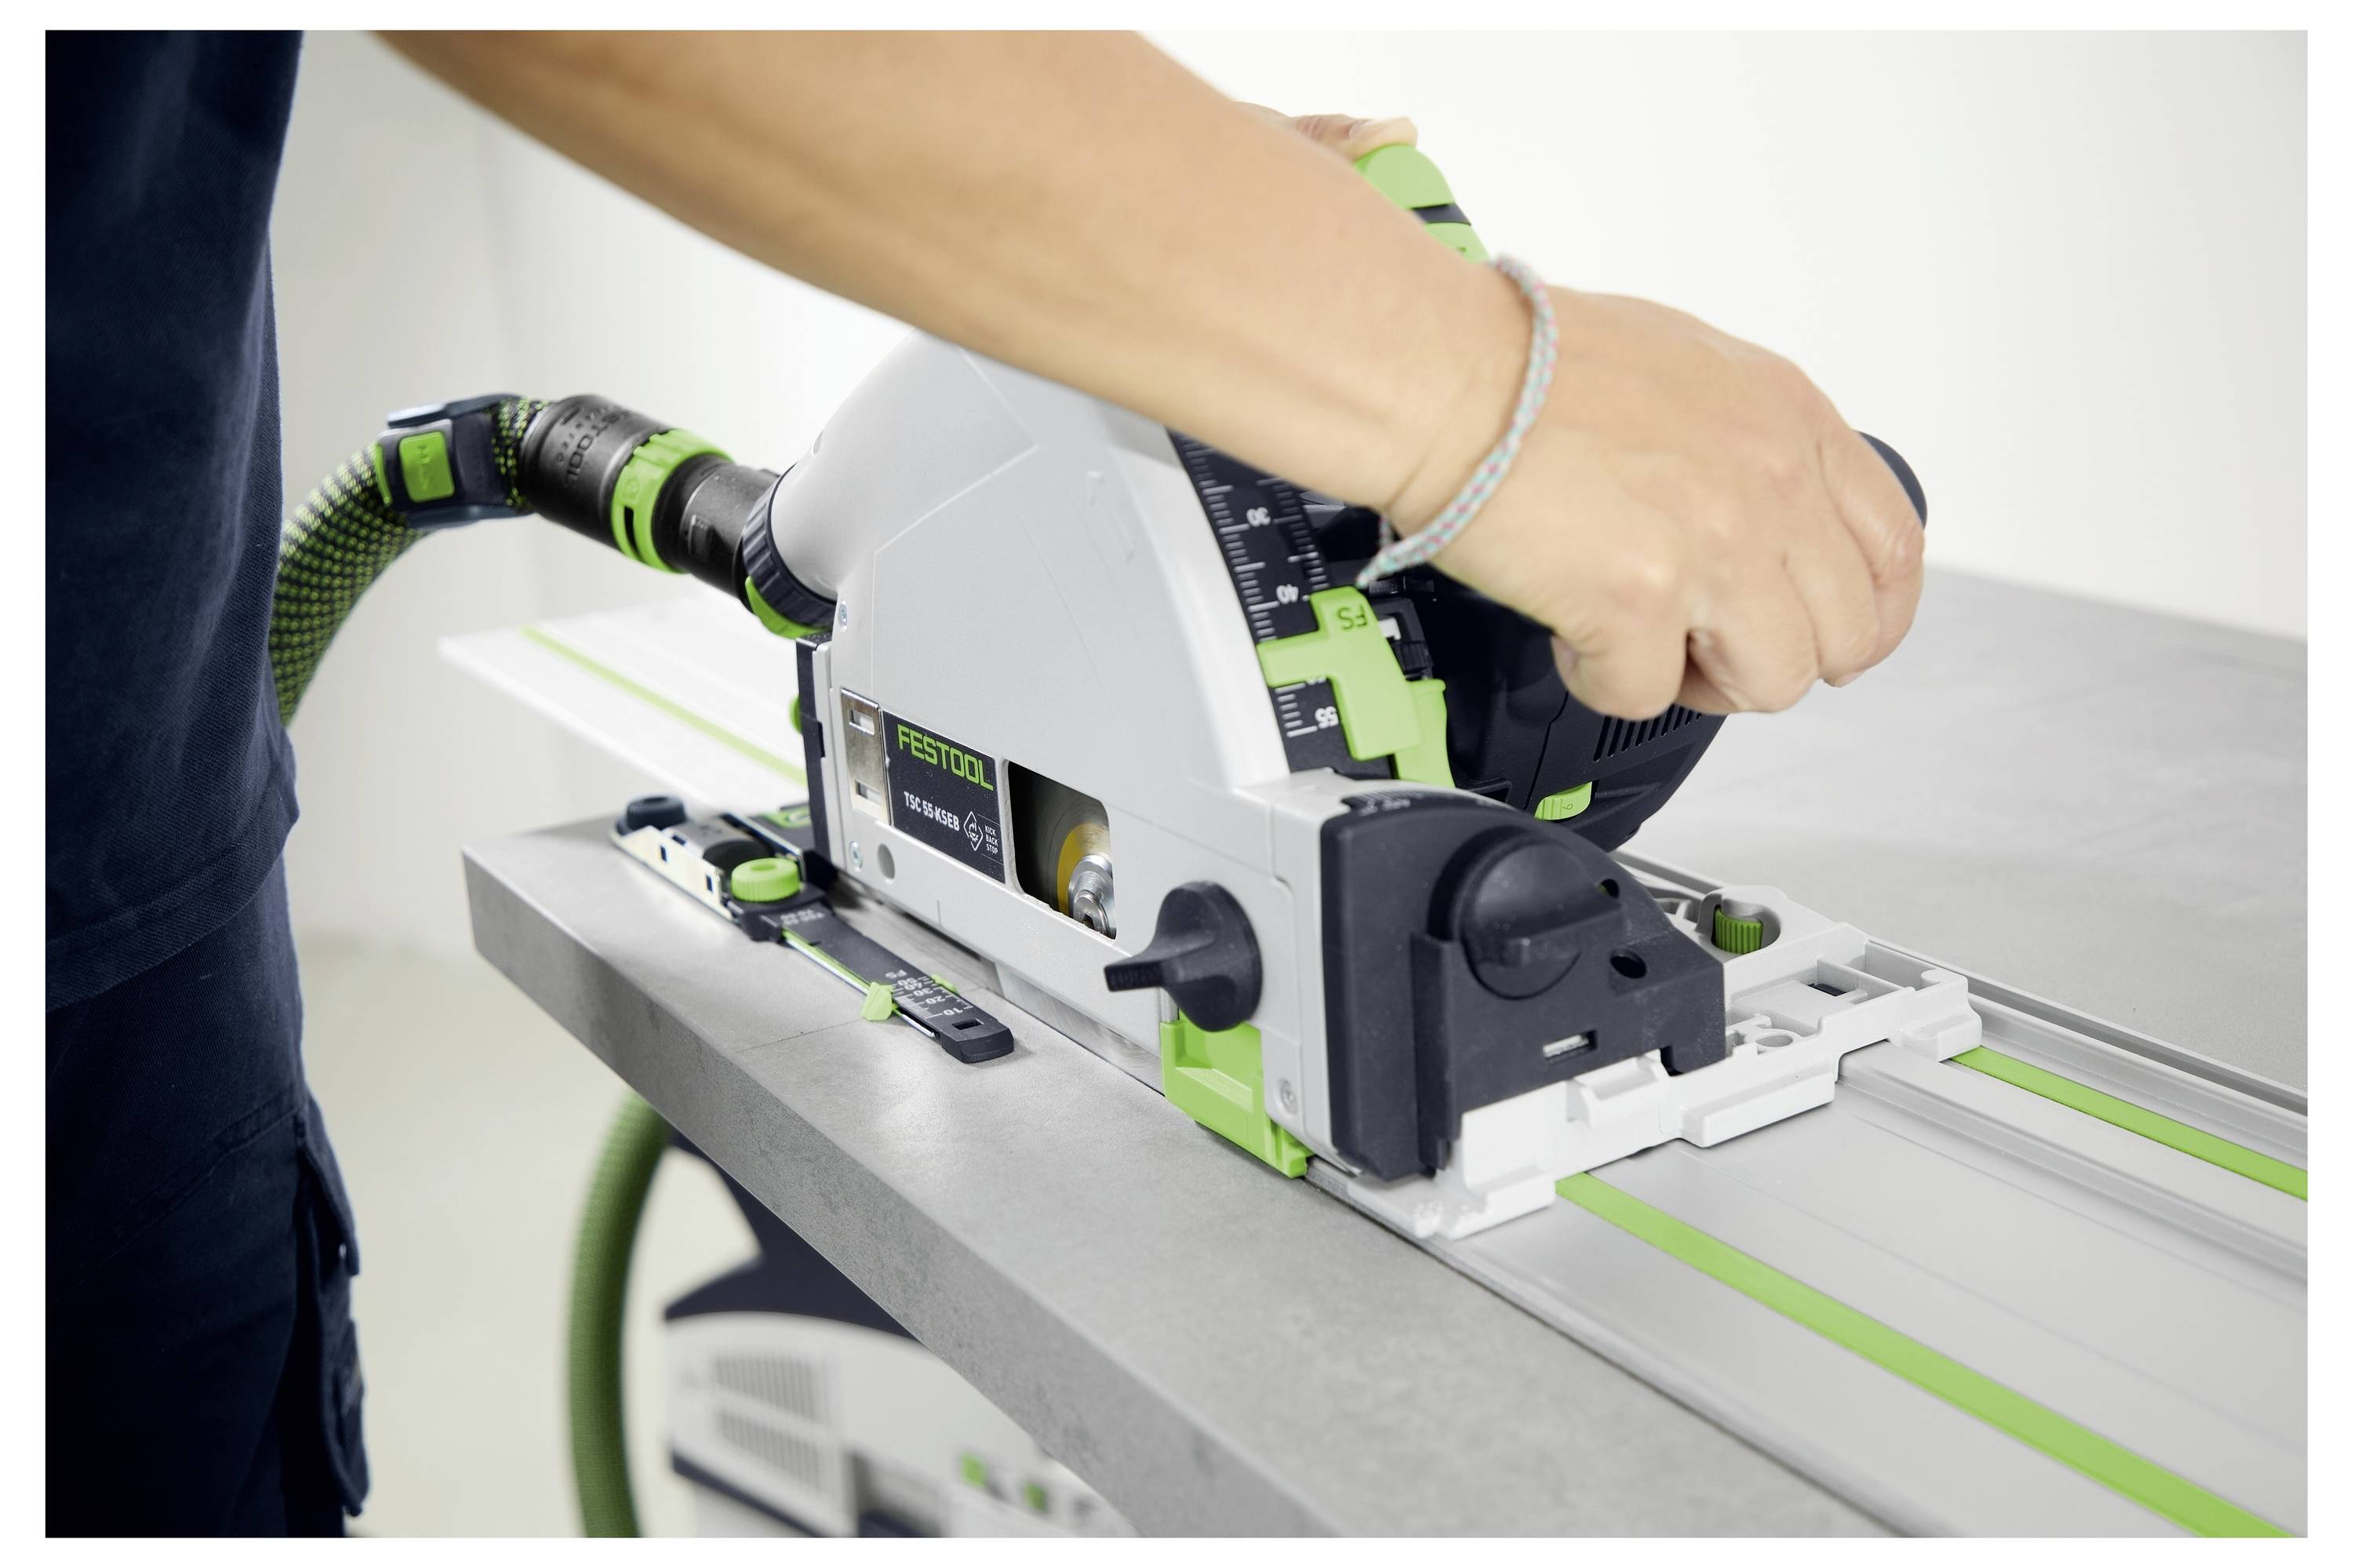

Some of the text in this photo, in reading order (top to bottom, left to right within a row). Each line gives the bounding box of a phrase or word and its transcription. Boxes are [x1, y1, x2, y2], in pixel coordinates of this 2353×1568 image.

[1246, 507, 1271, 527] 30
[1275, 584, 1300, 605] 40
[1337, 605, 1368, 630] FS
[1315, 706, 1338, 729] 55
[896, 723, 994, 791] FESTOOL
[904, 791, 960, 831] TSC 55 KSEB
[984, 824, 996, 837] KICK
[985, 834, 998, 846] BACK
[986, 843, 998, 855] STOP
[913, 988, 933, 997] 30
[926, 995, 946, 1004] 20
[943, 1007, 963, 1016] 10
